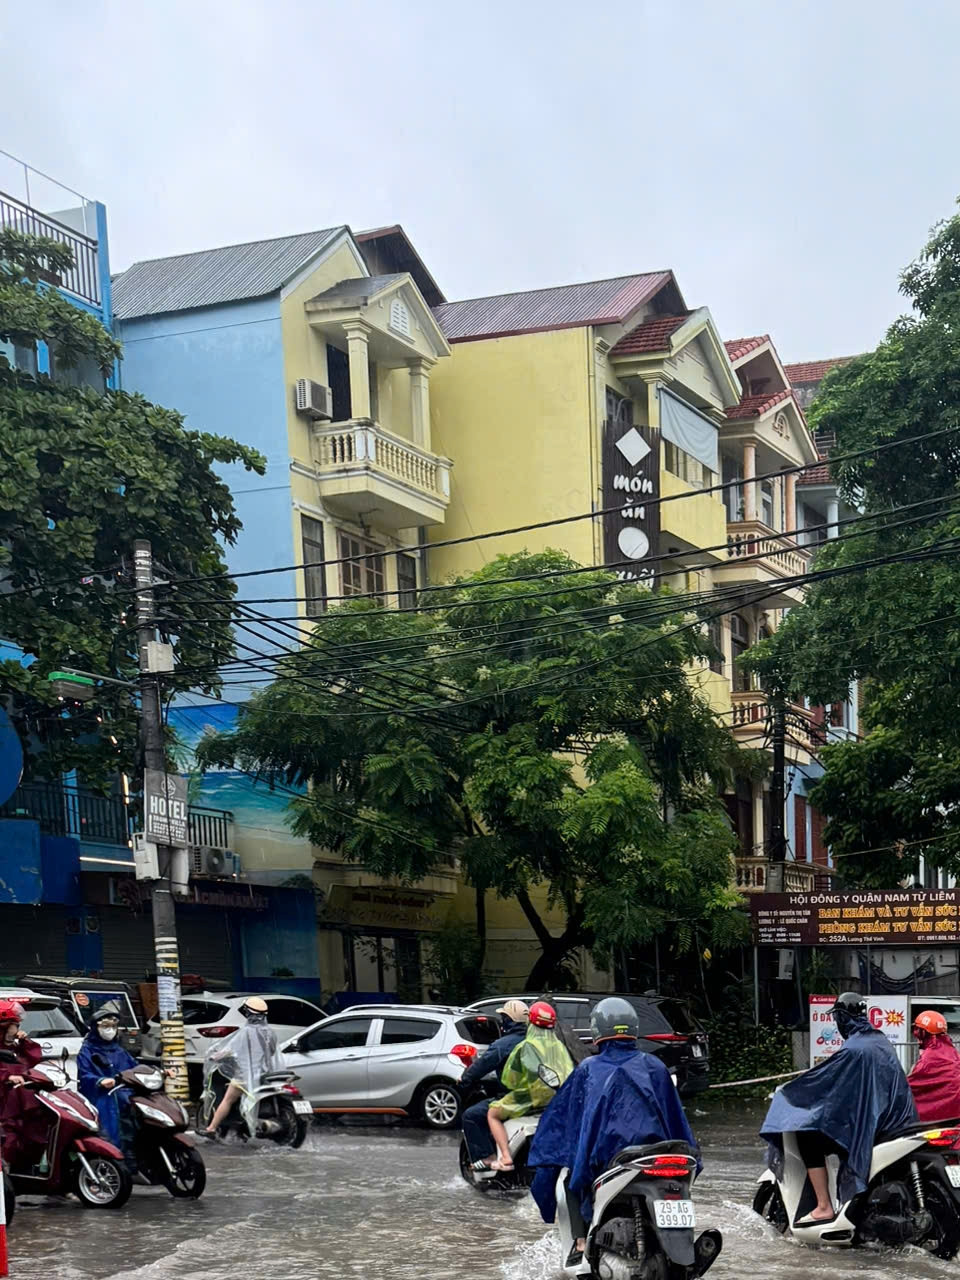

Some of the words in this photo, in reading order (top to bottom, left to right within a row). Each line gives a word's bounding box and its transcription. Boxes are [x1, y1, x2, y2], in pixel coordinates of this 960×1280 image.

[613, 470, 653, 494] món
[621, 497, 645, 520] ăn
[150, 795, 187, 820] HOTEL
[790, 894, 808, 905] HỘI
[810, 893, 840, 904] ĐÔNG
[842, 894, 850, 904] Y
[852, 892, 881, 904] QUẬN
[885, 893, 910, 902] NAM
[912, 891, 926, 902] TỪ
[929, 891, 956, 901] LIÊM
[818, 908, 841, 918] BAN
[842, 905, 875, 918] KHÁM
[857, 920, 891, 933] KHÁM
[659, 1214, 693, 1226] 399.07
